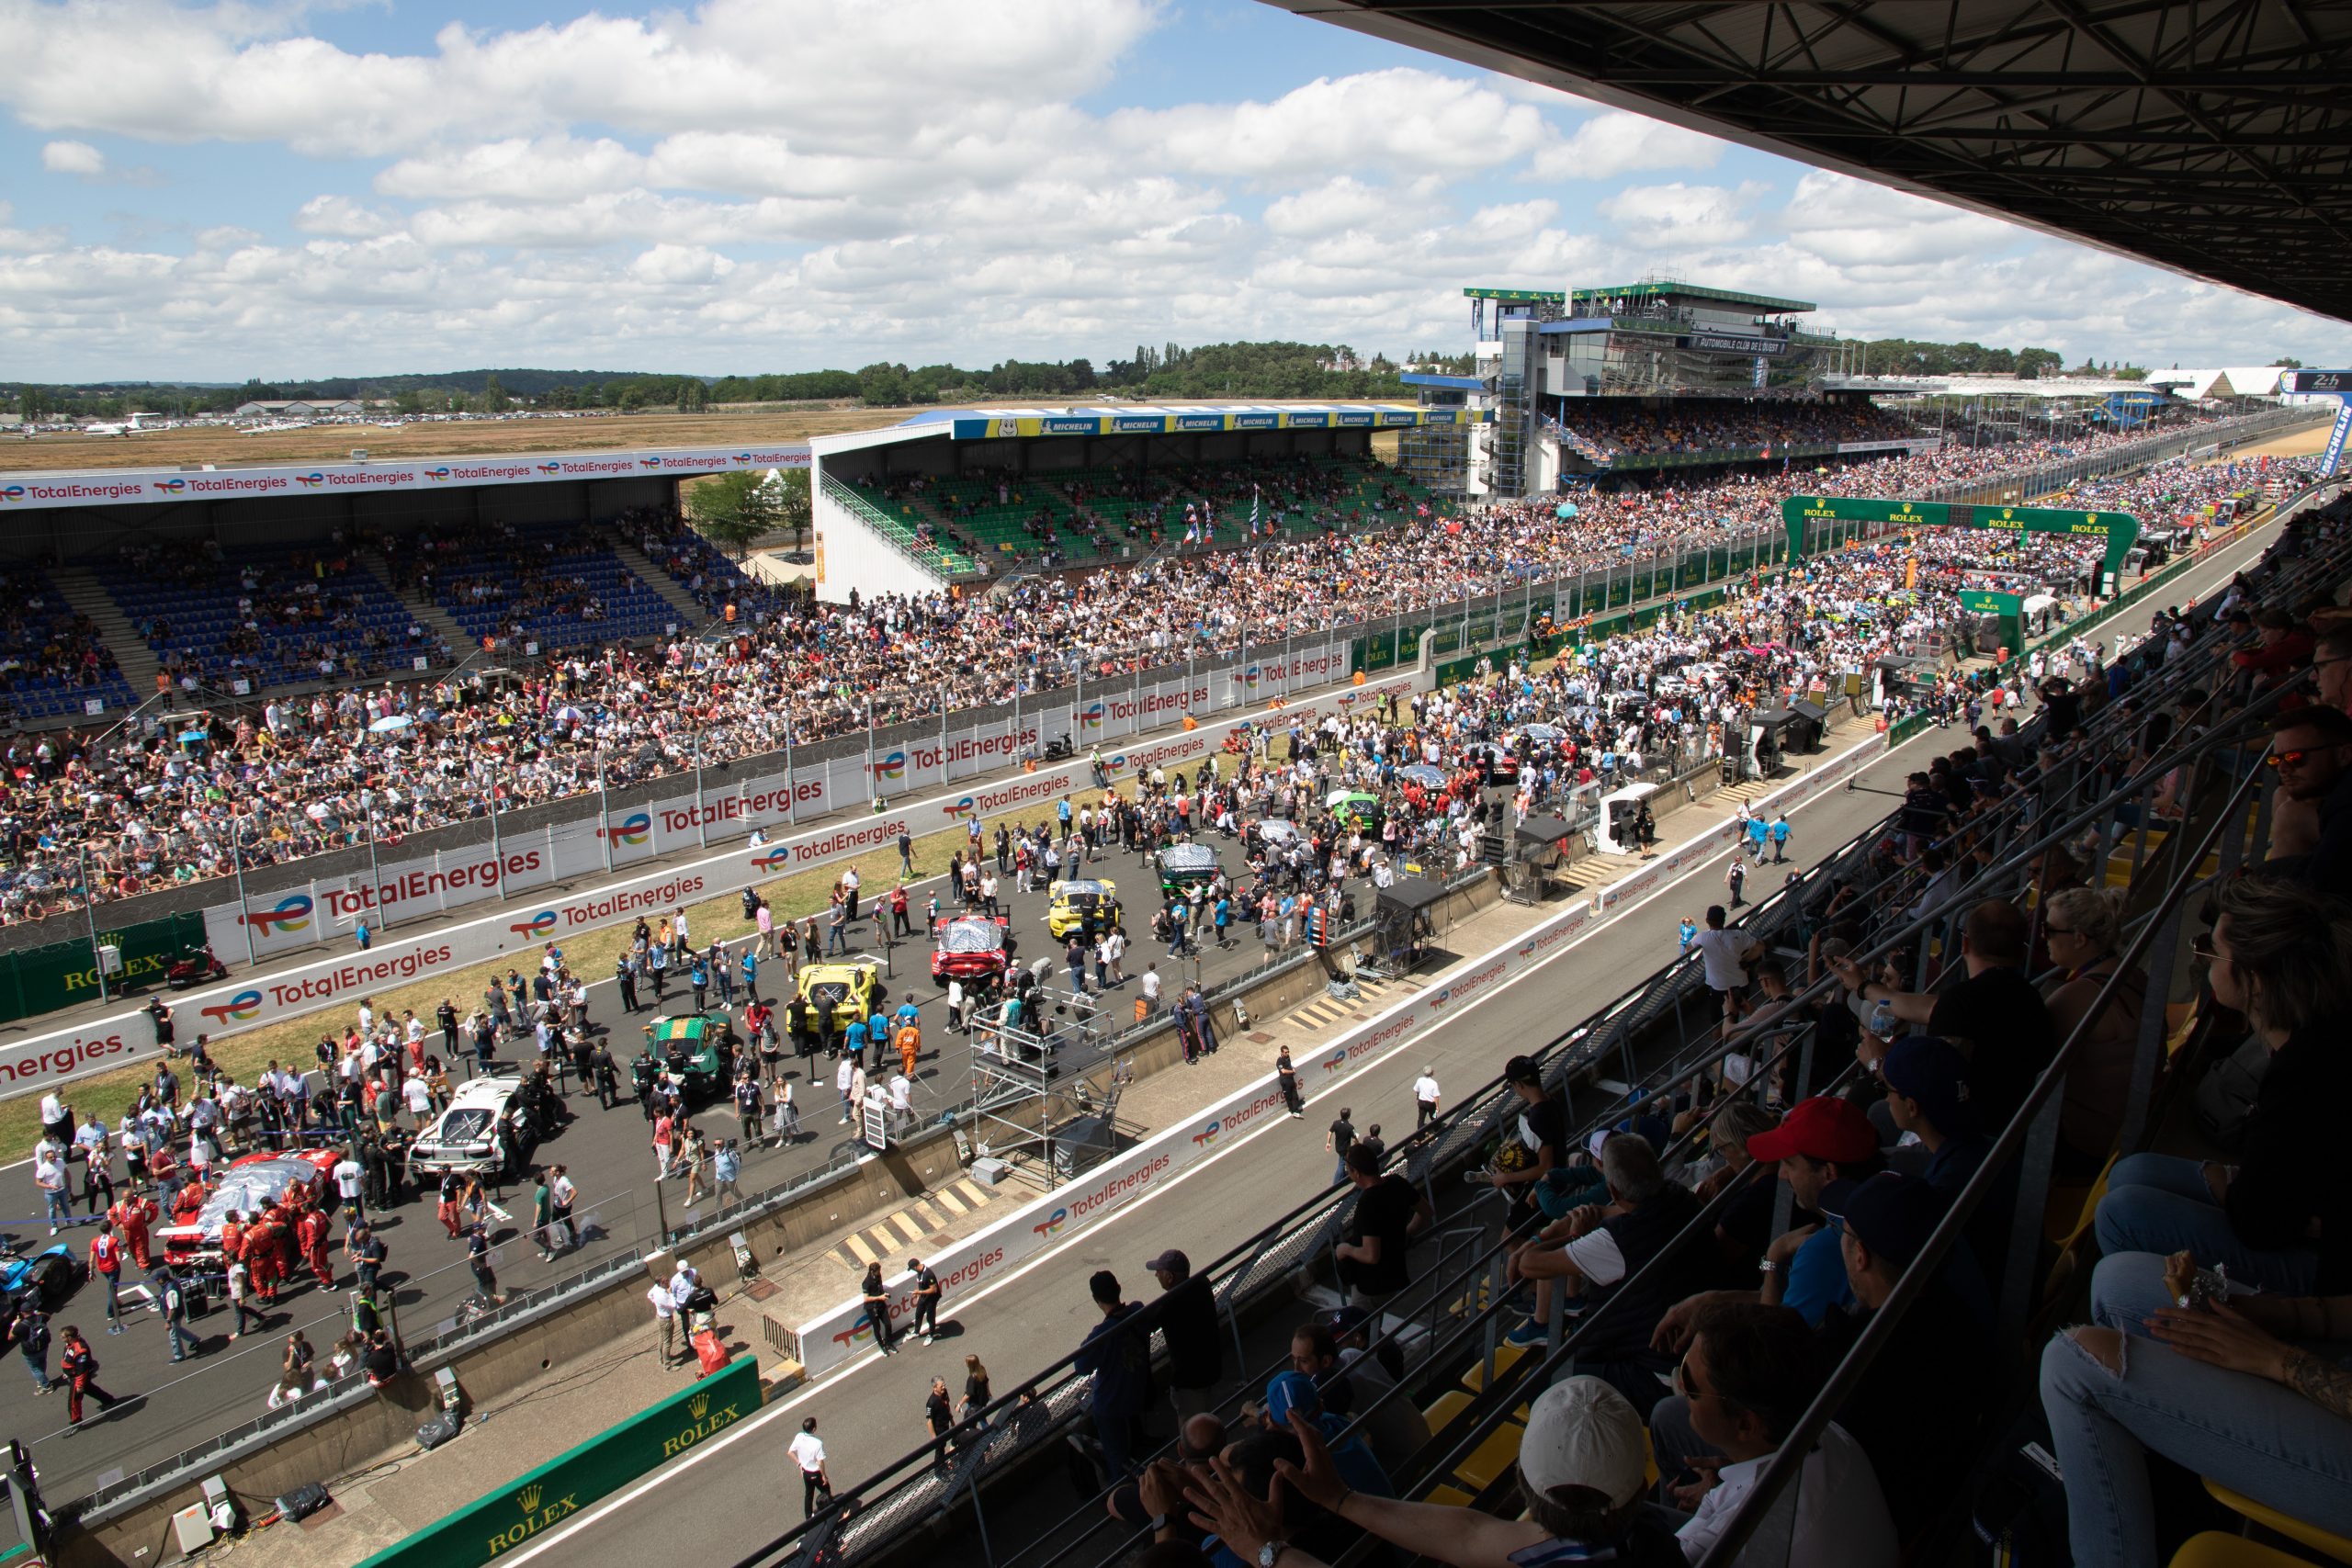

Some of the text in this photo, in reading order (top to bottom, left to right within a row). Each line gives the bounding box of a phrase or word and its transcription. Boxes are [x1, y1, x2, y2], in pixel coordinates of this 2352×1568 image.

[1700, 338, 1736, 349] AUTOMOBILE
[1736, 341, 1750, 350] CLUB
[1053, 423, 1093, 431] MICHELIN
[1122, 421, 1158, 429] MICHELIN
[2321, 405, 2352, 474] MICHELIN
[452, 465, 530, 479] TotalEnergies
[561, 460, 633, 474] TotalEnergies
[662, 456, 727, 468] TotalEnergies
[753, 452, 811, 464] TotalEnergies
[28, 483, 141, 499] TotalEnergies
[188, 476, 287, 491] TotalEnergies
[326, 471, 414, 486] TotalEnergies
[1804, 509, 1835, 518] ROLEX
[1889, 514, 1923, 523] ROLEX
[1988, 519, 2024, 529] ROLEX
[2071, 525, 2109, 534] ROLEX
[1264, 654, 1343, 682] TotlEnergies
[1108, 687, 1208, 720] TotalEnerges
[911, 728, 1037, 770] TotalEnergies
[1127, 738, 1204, 768] TotalEnergies
[659, 781, 822, 833] TotalEnergies
[977, 775, 1069, 811] TotalEnergies
[793, 820, 905, 862] TotalEnergies
[1679, 840, 1714, 866] TotalEnergies
[321, 850, 540, 917] TotalEnergies
[1619, 874, 1658, 903] TotalEnergies
[562, 877, 703, 926] TotalEnergies
[1536, 917, 1584, 951] TotalEnergies
[269, 945, 452, 1007] TotalEnergies
[1451, 961, 1506, 1000] TotalEnergies
[1348, 1014, 1414, 1060] TotalEnergies
[1222, 1077, 1303, 1132] TotalEnerges
[1070, 1154, 1170, 1219] TotalEnergies
[888, 1247, 1003, 1320] otanergies
[662, 1403, 740, 1459] ROLEX
[487, 1492, 579, 1557] ROLEX
